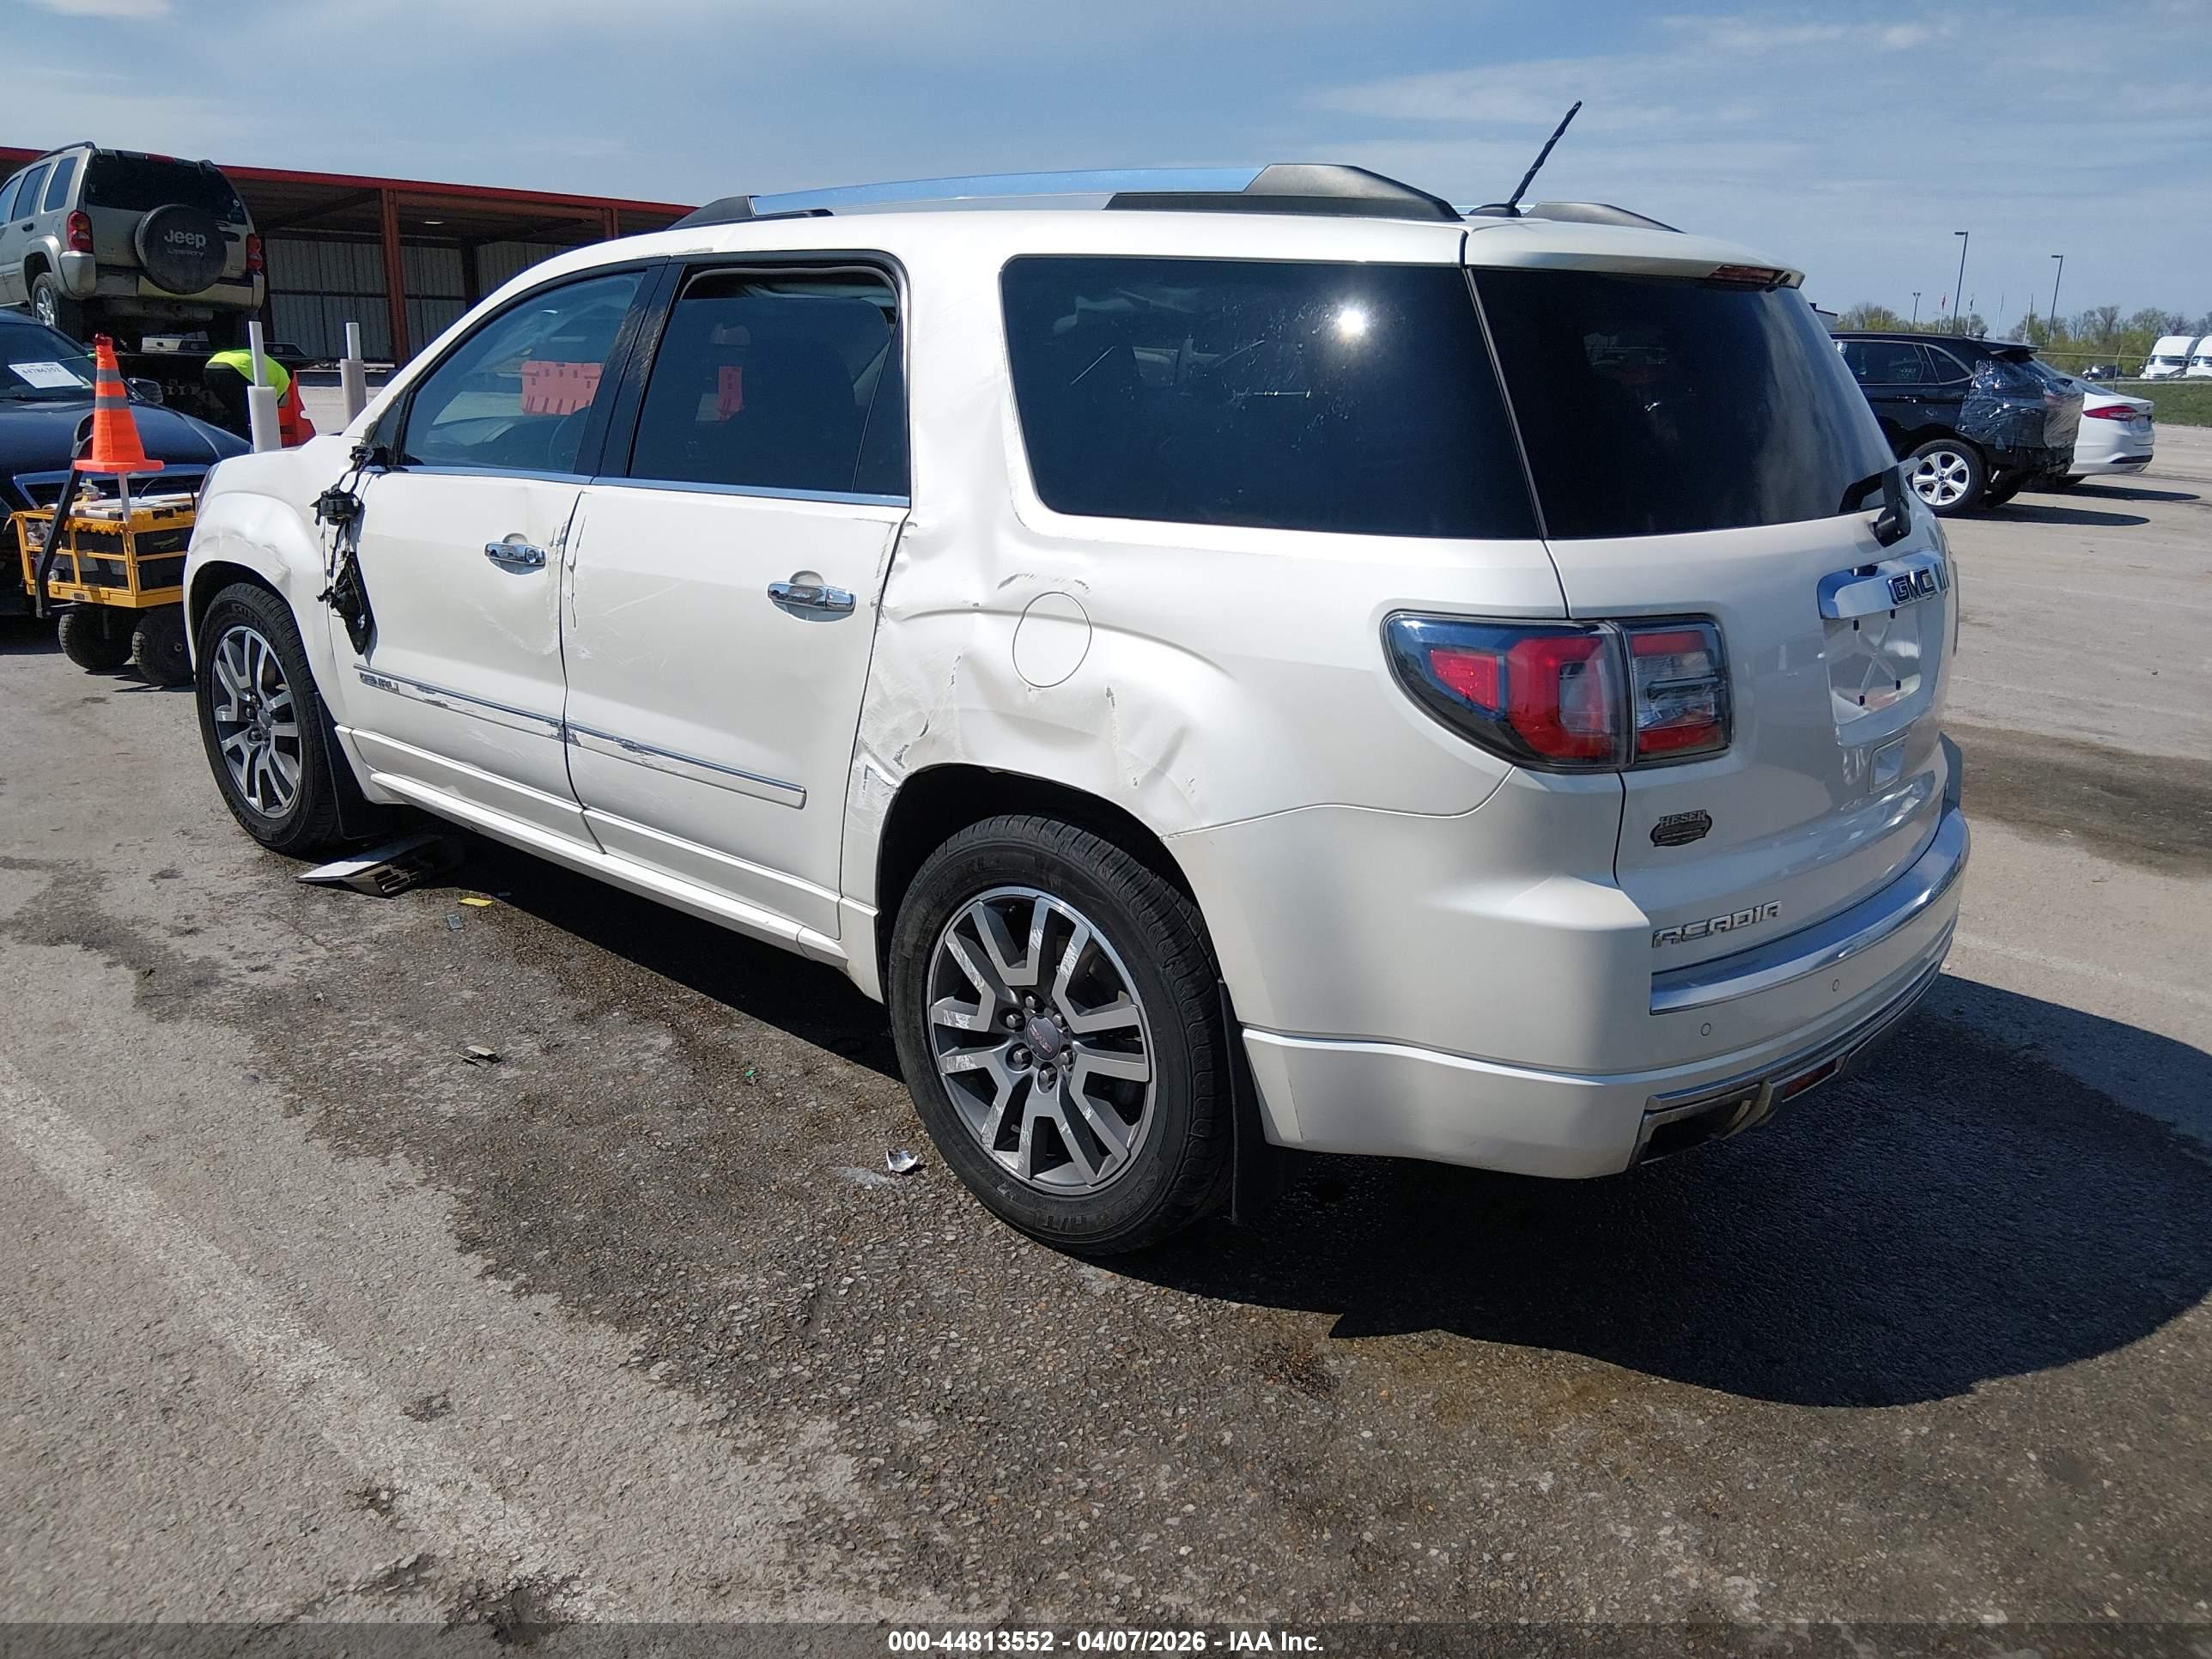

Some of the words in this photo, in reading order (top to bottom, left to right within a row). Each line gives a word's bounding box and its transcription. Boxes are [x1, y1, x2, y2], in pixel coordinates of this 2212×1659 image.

[164, 228, 206, 248] Jeep
[1887, 568, 1937, 604] GMC
[1659, 810, 1706, 827] HESER
[1651, 900, 1782, 948] ACADIA
